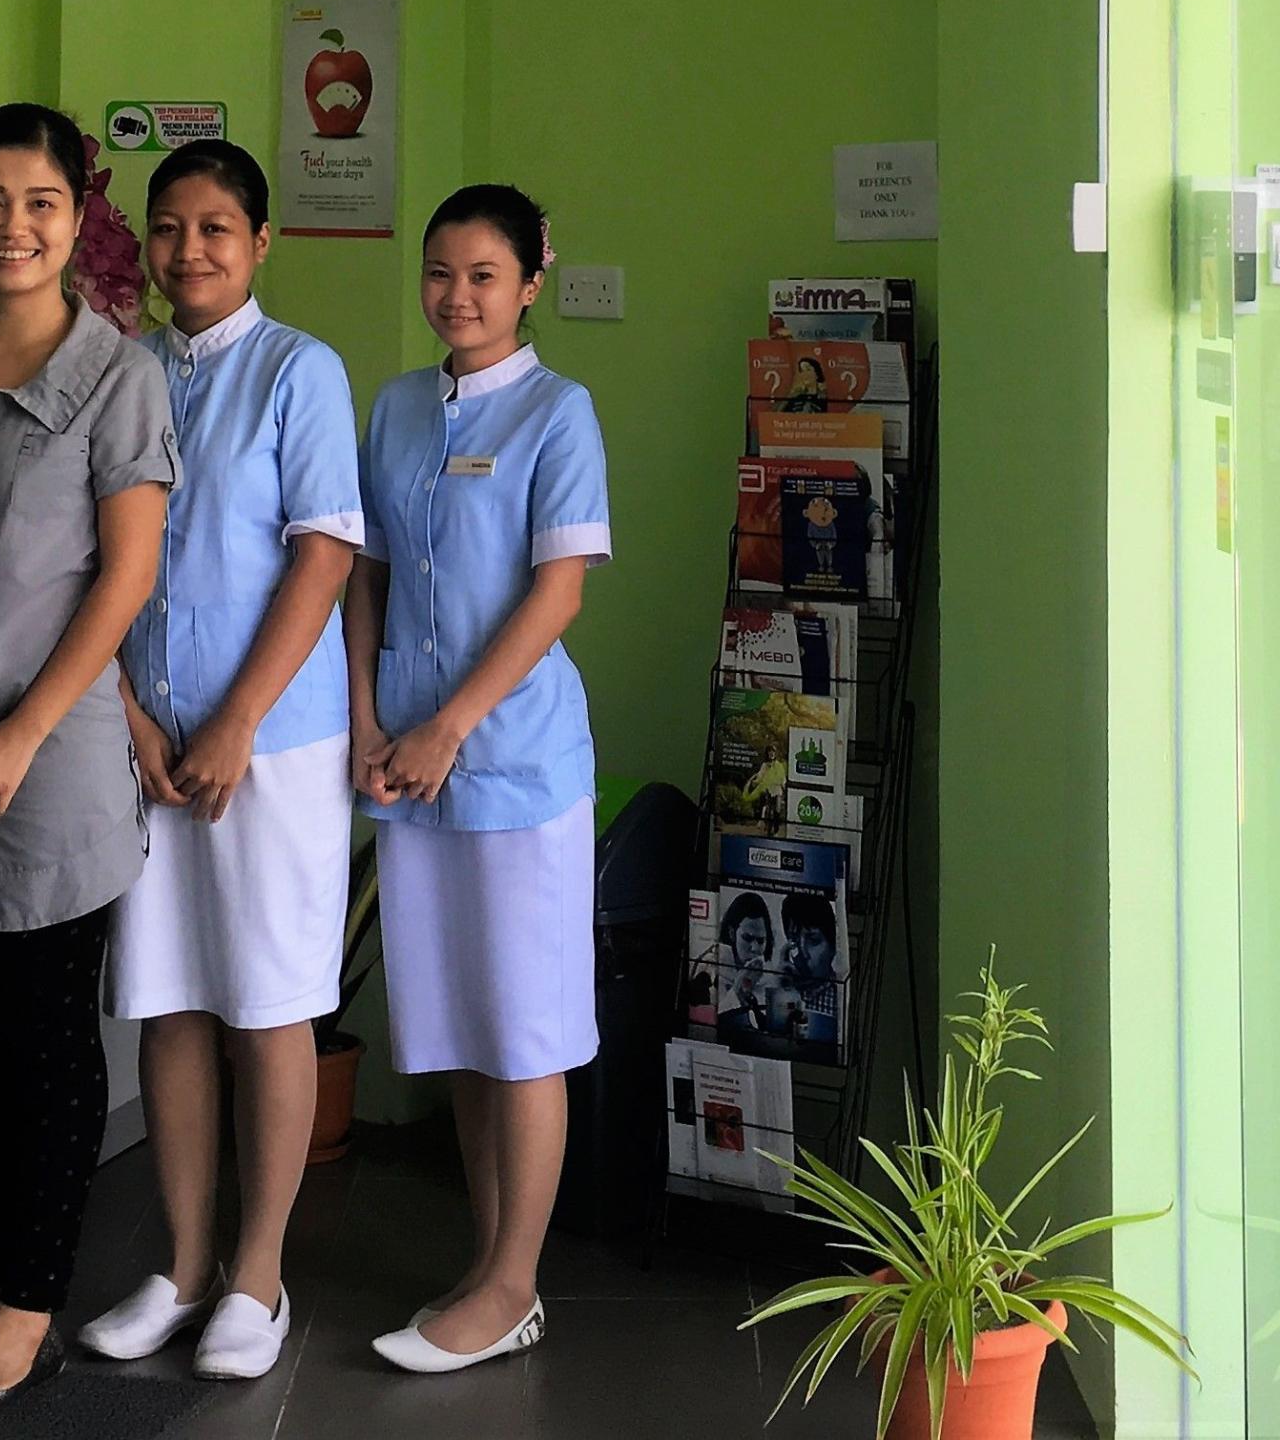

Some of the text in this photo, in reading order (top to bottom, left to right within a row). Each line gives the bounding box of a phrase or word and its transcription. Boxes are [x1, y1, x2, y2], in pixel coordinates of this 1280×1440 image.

[876, 161, 892, 170] FOR
[874, 192, 897, 202] ONLY
[859, 208, 888, 218] THANK
[750, 651, 794, 664] MEBO
